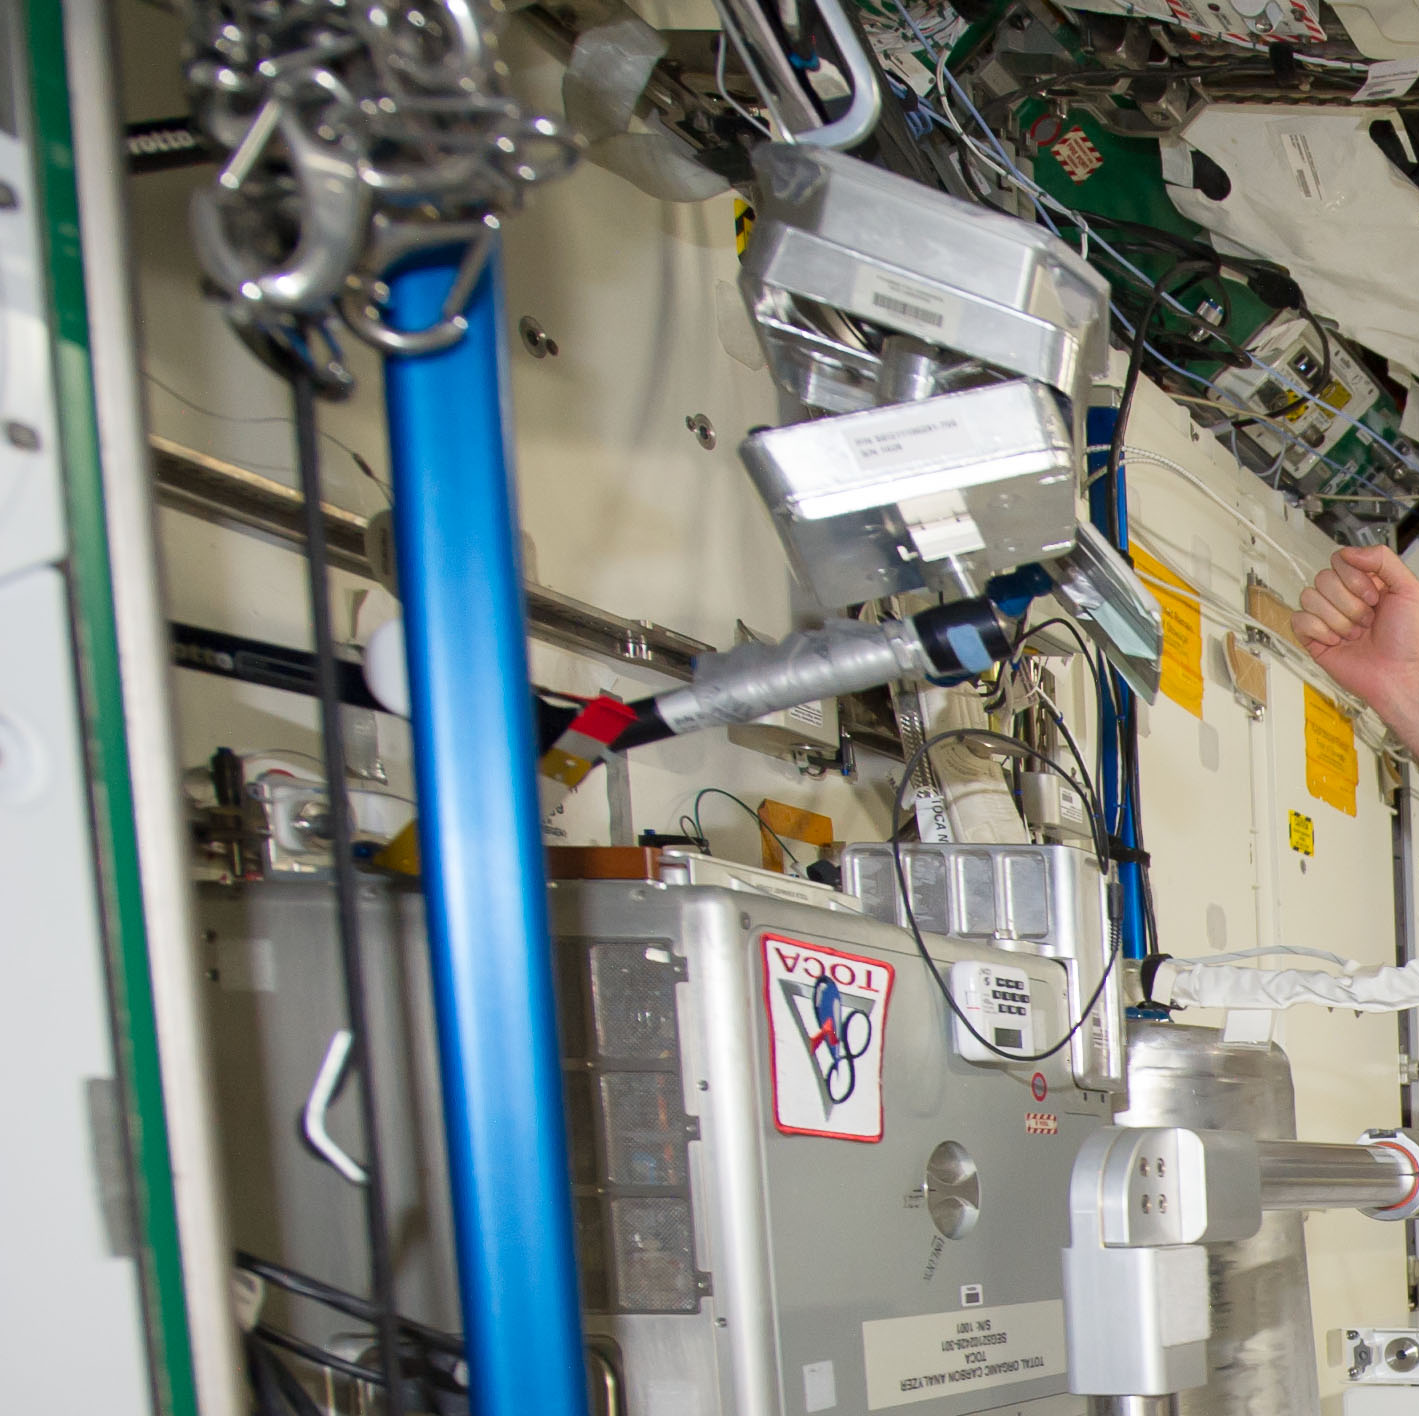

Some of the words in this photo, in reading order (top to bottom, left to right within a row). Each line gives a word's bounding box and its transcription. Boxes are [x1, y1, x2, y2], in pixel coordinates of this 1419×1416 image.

[774, 946, 881, 993] TOCA
[964, 1350, 988, 1364] TOCA
[1020, 1356, 1045, 1370] TOTAL
[948, 1366, 984, 1384] CARBON
[984, 1359, 1020, 1377] ORGANIC
[900, 1374, 948, 1392] ANALYZER
